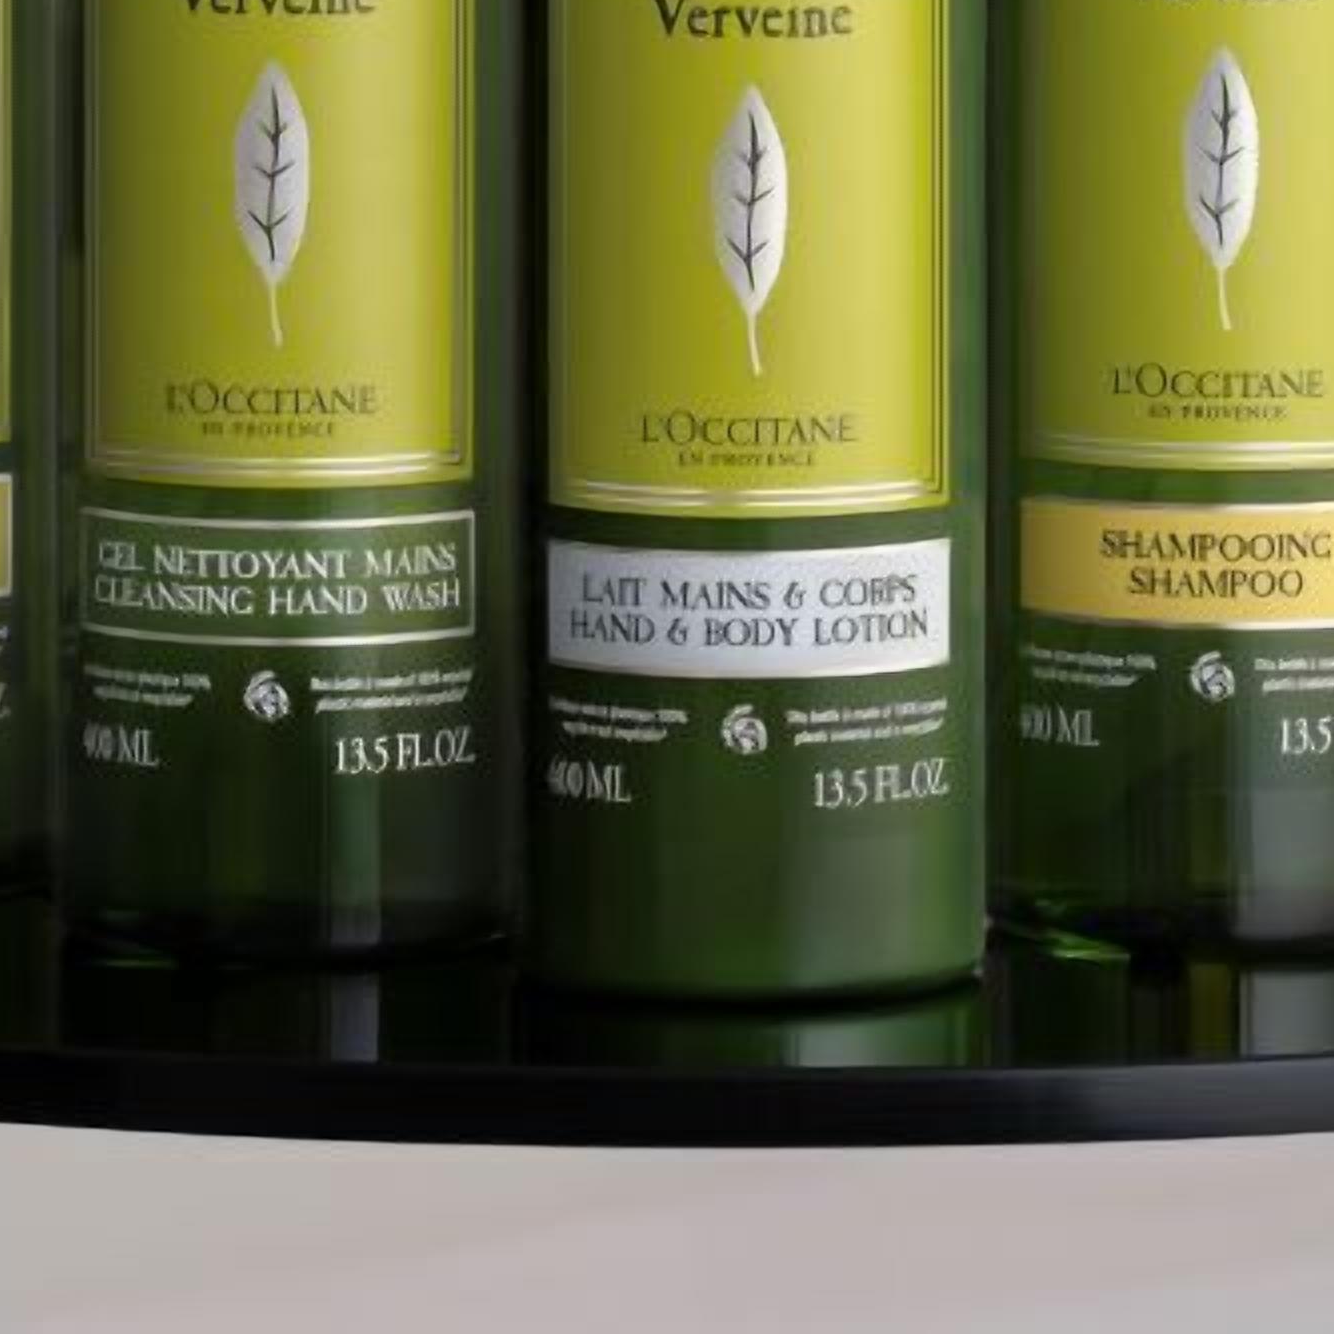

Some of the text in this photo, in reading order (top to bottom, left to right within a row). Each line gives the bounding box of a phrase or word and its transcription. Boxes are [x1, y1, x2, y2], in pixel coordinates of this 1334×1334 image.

[98, 541, 458, 578] GEL NETTOYANT MAINS
[1101, 528, 1333, 562] SHAMPOOING
[95, 575, 460, 615] CLEANSING HAND WASH
[582, 573, 918, 611] LAIT MAINS & CORPS
[1129, 569, 1304, 598] SHAMPOO
[571, 609, 928, 647] HAND & BODY LOTION
